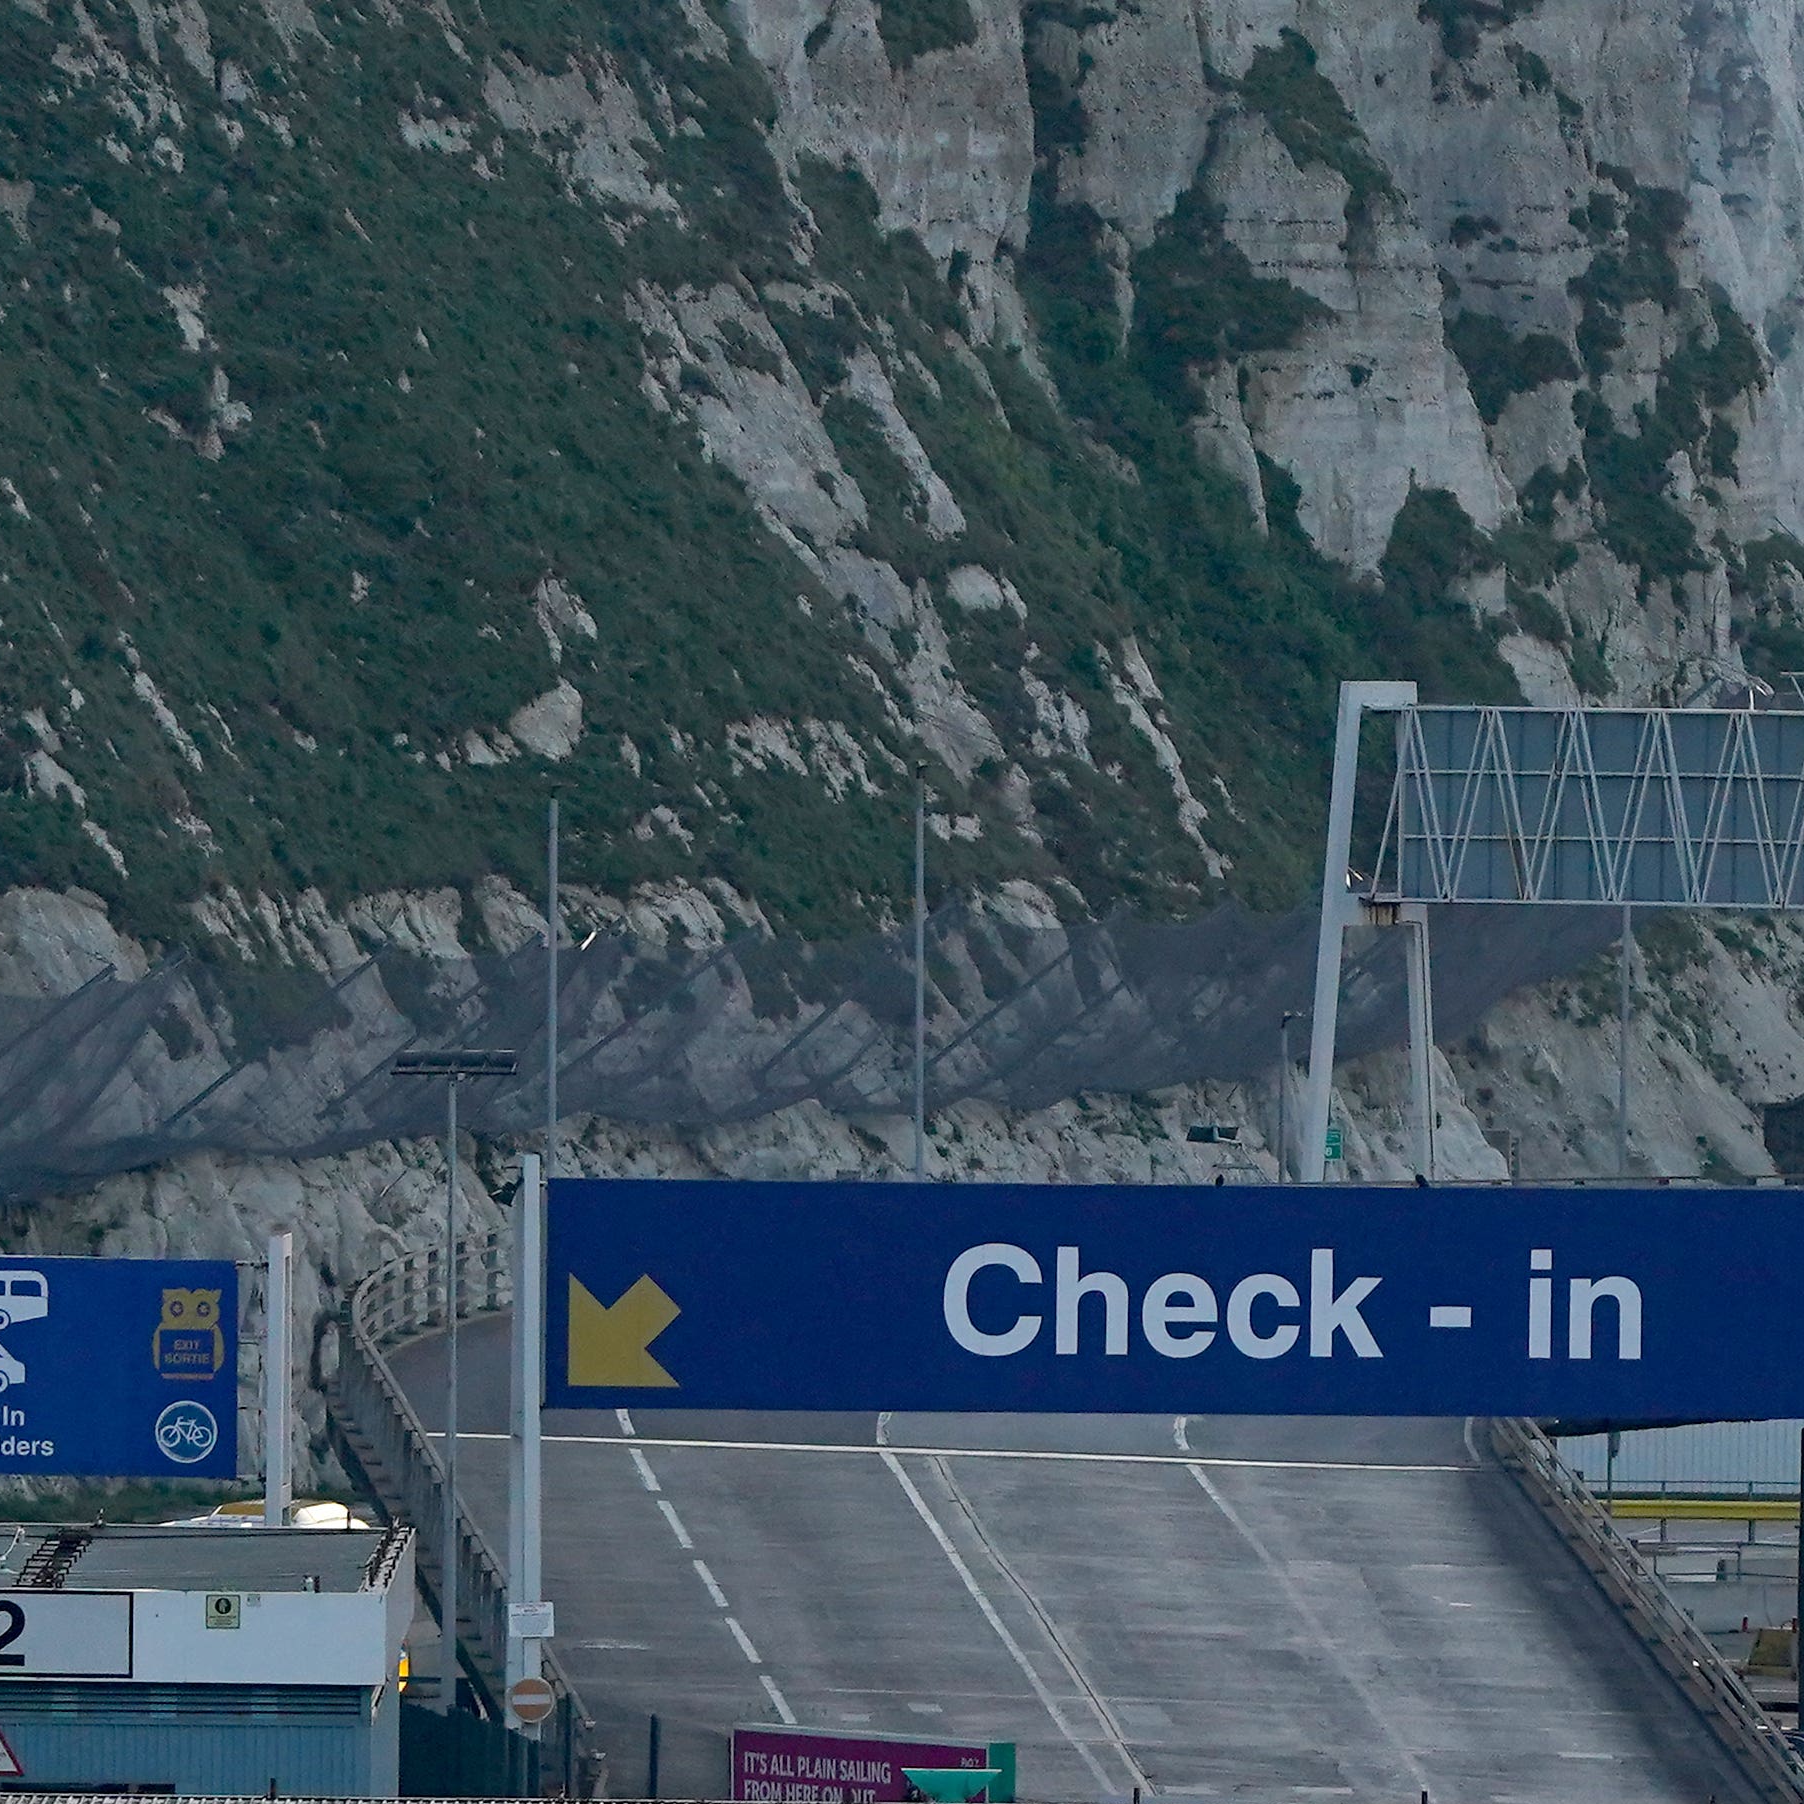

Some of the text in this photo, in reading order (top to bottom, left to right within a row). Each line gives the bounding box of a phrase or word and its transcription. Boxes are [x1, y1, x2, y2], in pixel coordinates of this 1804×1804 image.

[944, 1242, 1384, 1358] Check
[1528, 1249, 1643, 1360] in
[174, 1339, 200, 1350] EXIT
[164, 1353, 210, 1364] SORTIE
[2, 1405, 25, 1426] In
[744, 1752, 891, 1784] IT'S ALL PLAIN SAILING
[744, 1780, 781, 1802] FROM
